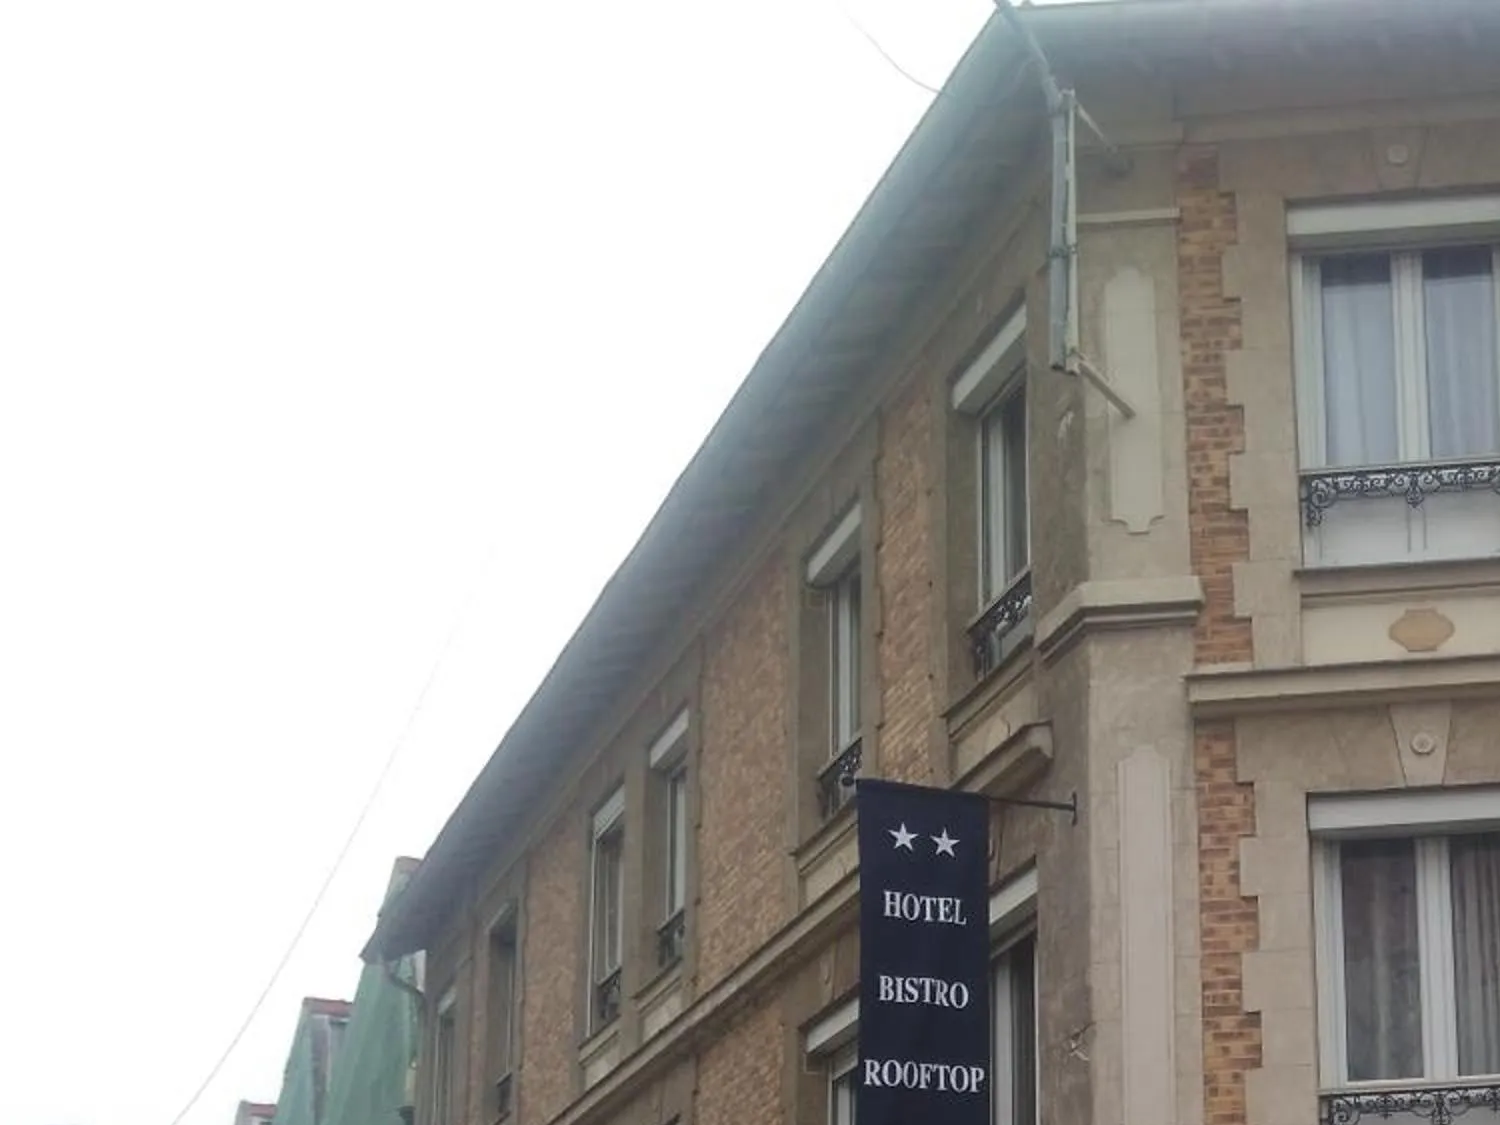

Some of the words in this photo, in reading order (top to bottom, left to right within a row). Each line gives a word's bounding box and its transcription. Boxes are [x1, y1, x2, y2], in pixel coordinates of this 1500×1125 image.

[884, 890, 967, 925] HOTEL
[879, 975, 969, 1009] BISTRO
[863, 1059, 985, 1094] ROOFTOP
